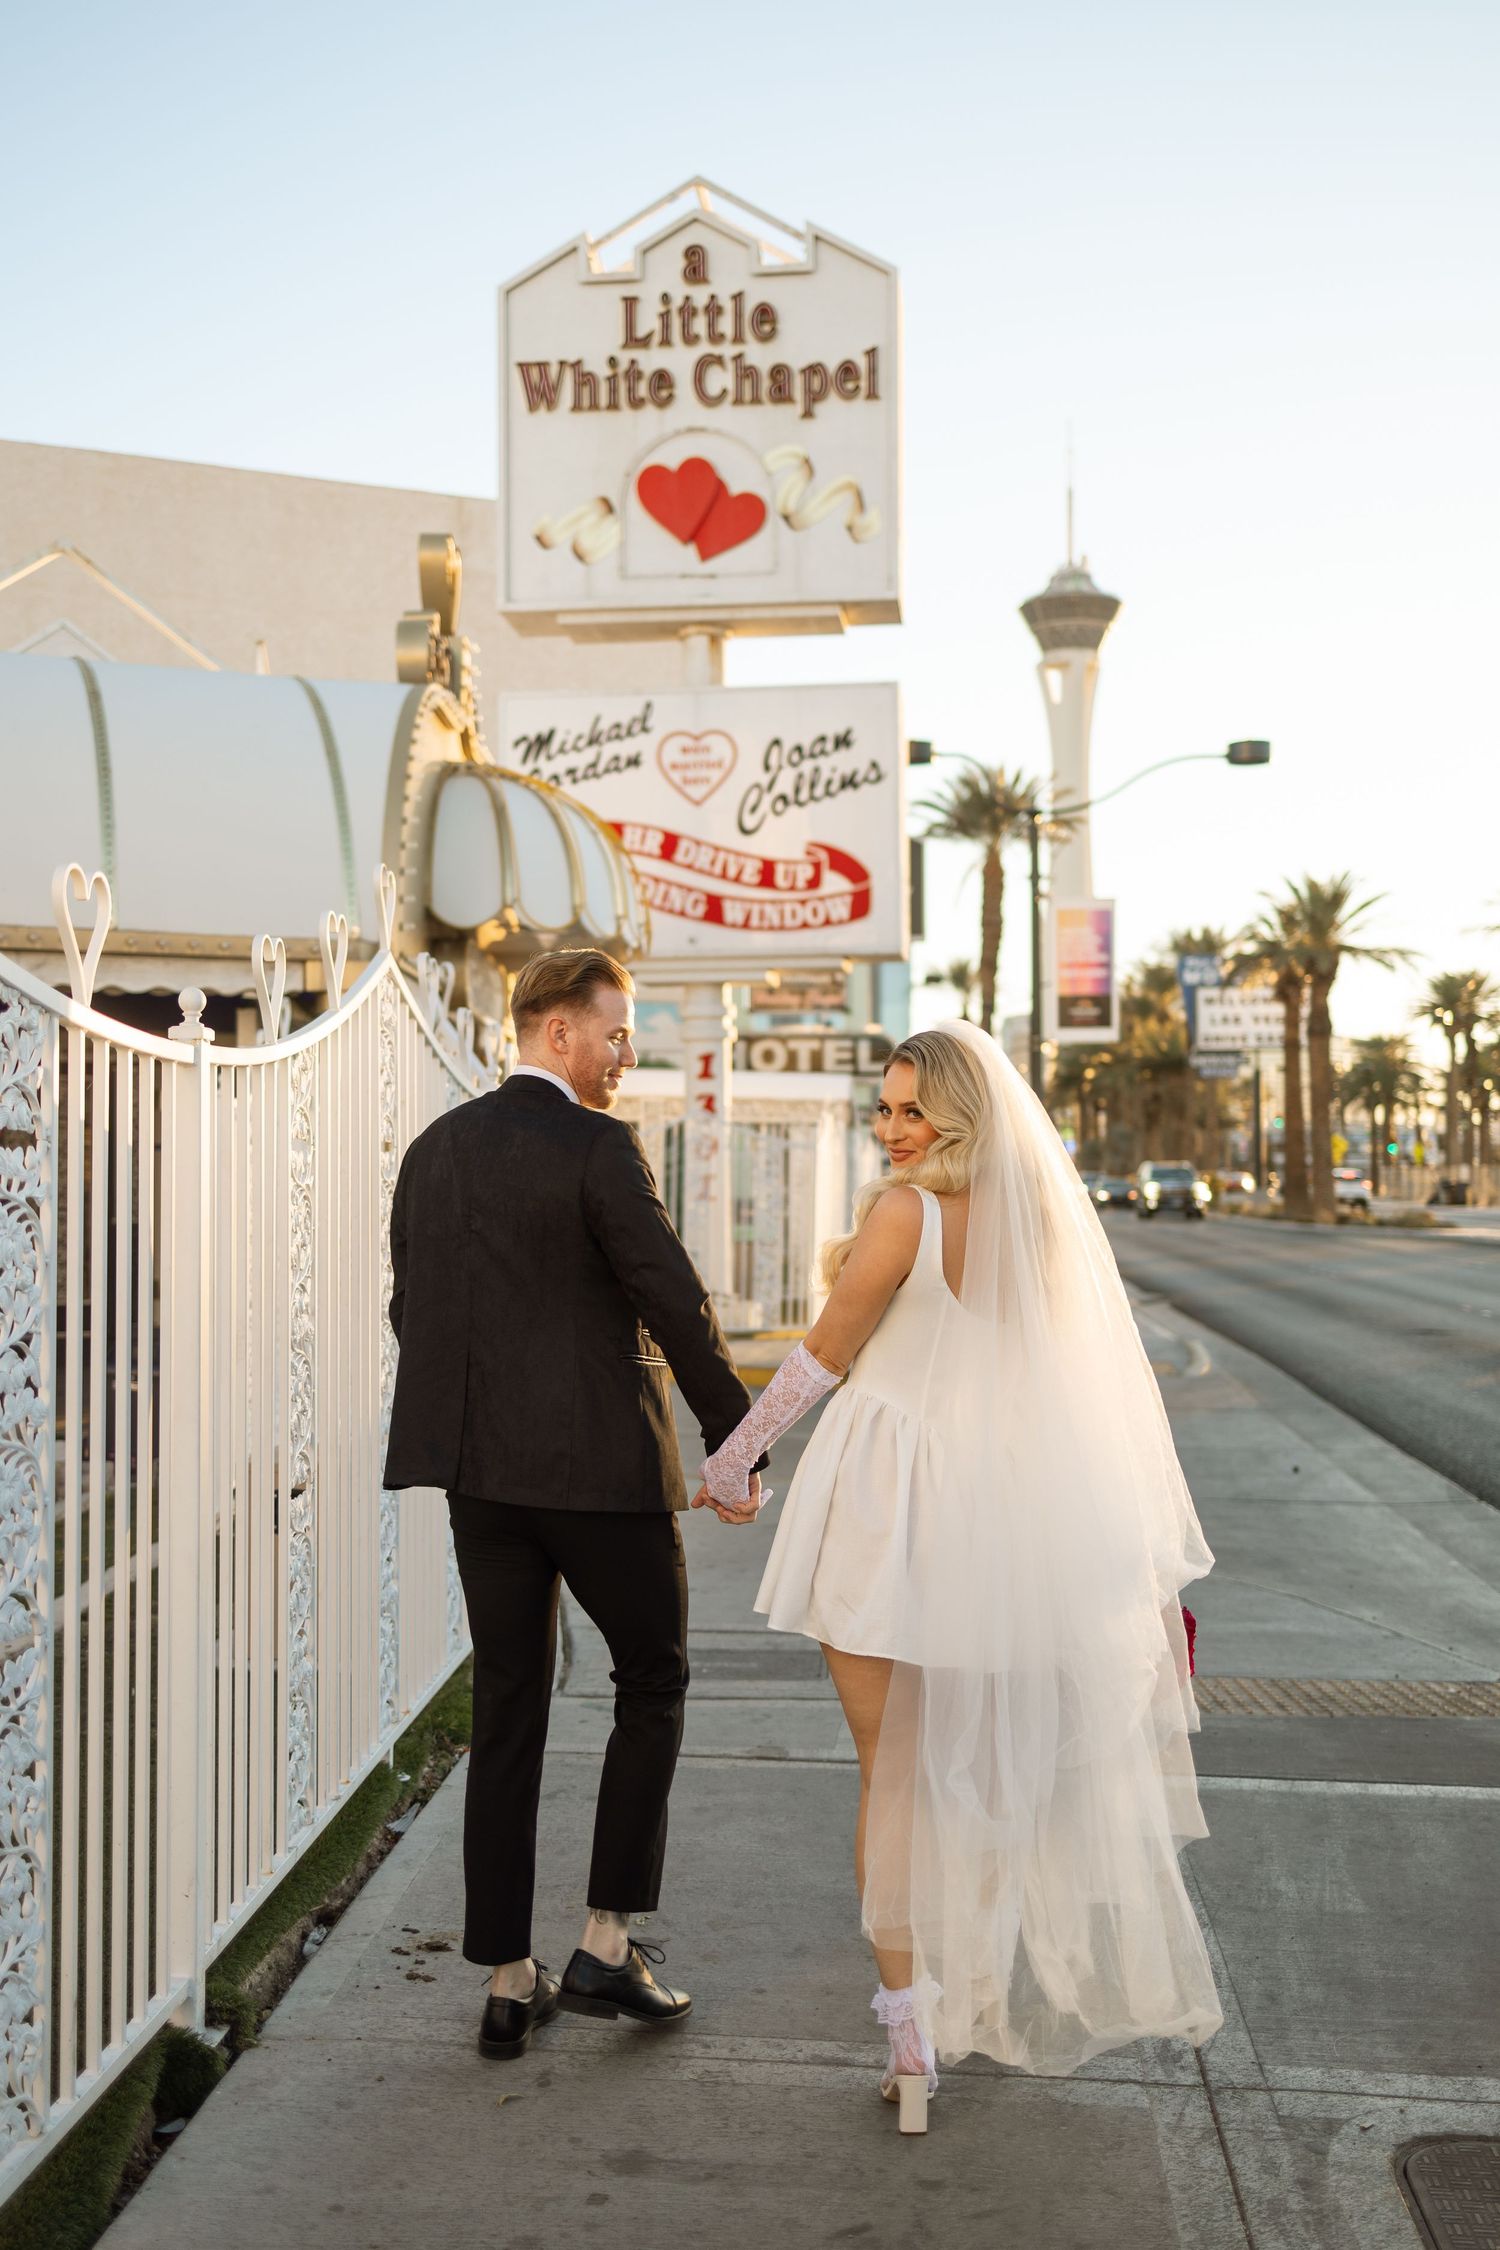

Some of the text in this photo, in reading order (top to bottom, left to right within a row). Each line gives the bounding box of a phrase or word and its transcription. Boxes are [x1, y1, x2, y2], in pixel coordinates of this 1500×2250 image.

[682, 244, 710, 284] a
[620, 291, 778, 350] Little
[516, 346, 881, 419] White Chapel
[513, 701, 655, 766] Michael
[763, 727, 855, 794] Joan
[737, 759, 888, 836] Collins
[673, 838, 763, 885] DRIVE
[774, 862, 815, 890] UP
[721, 894, 853, 928] WINDOW
